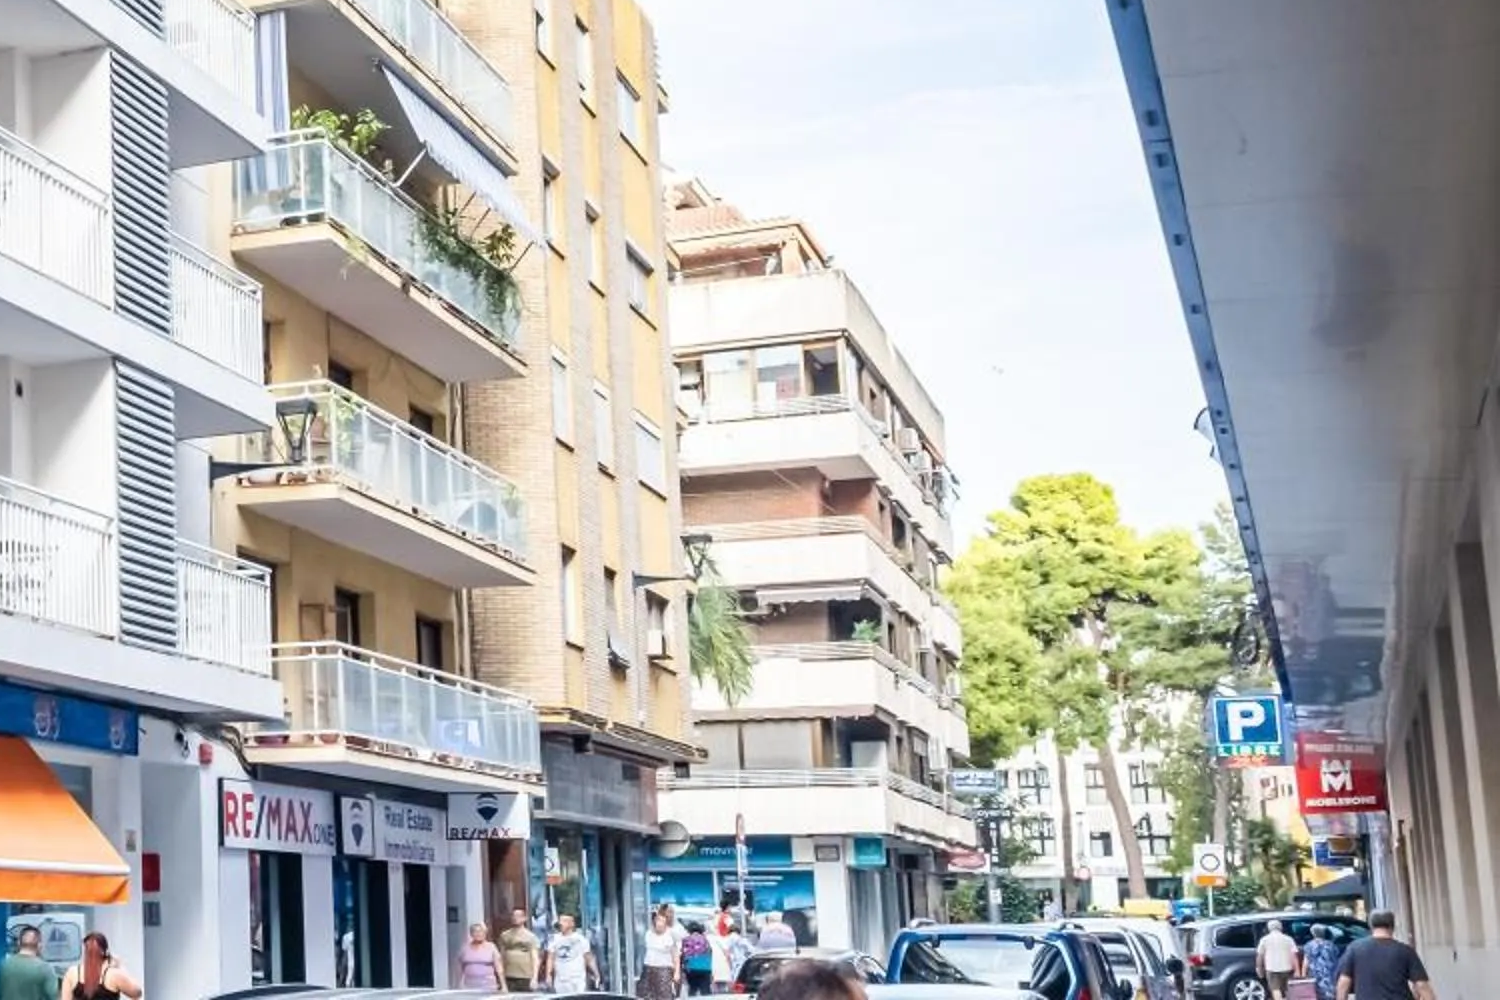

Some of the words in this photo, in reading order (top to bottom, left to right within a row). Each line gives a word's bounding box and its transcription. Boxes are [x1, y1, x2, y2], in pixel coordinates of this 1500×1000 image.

[1226, 701, 1265, 741] P
[1218, 745, 1281, 757] LIBRE
[225, 790, 313, 844] RE/MAX
